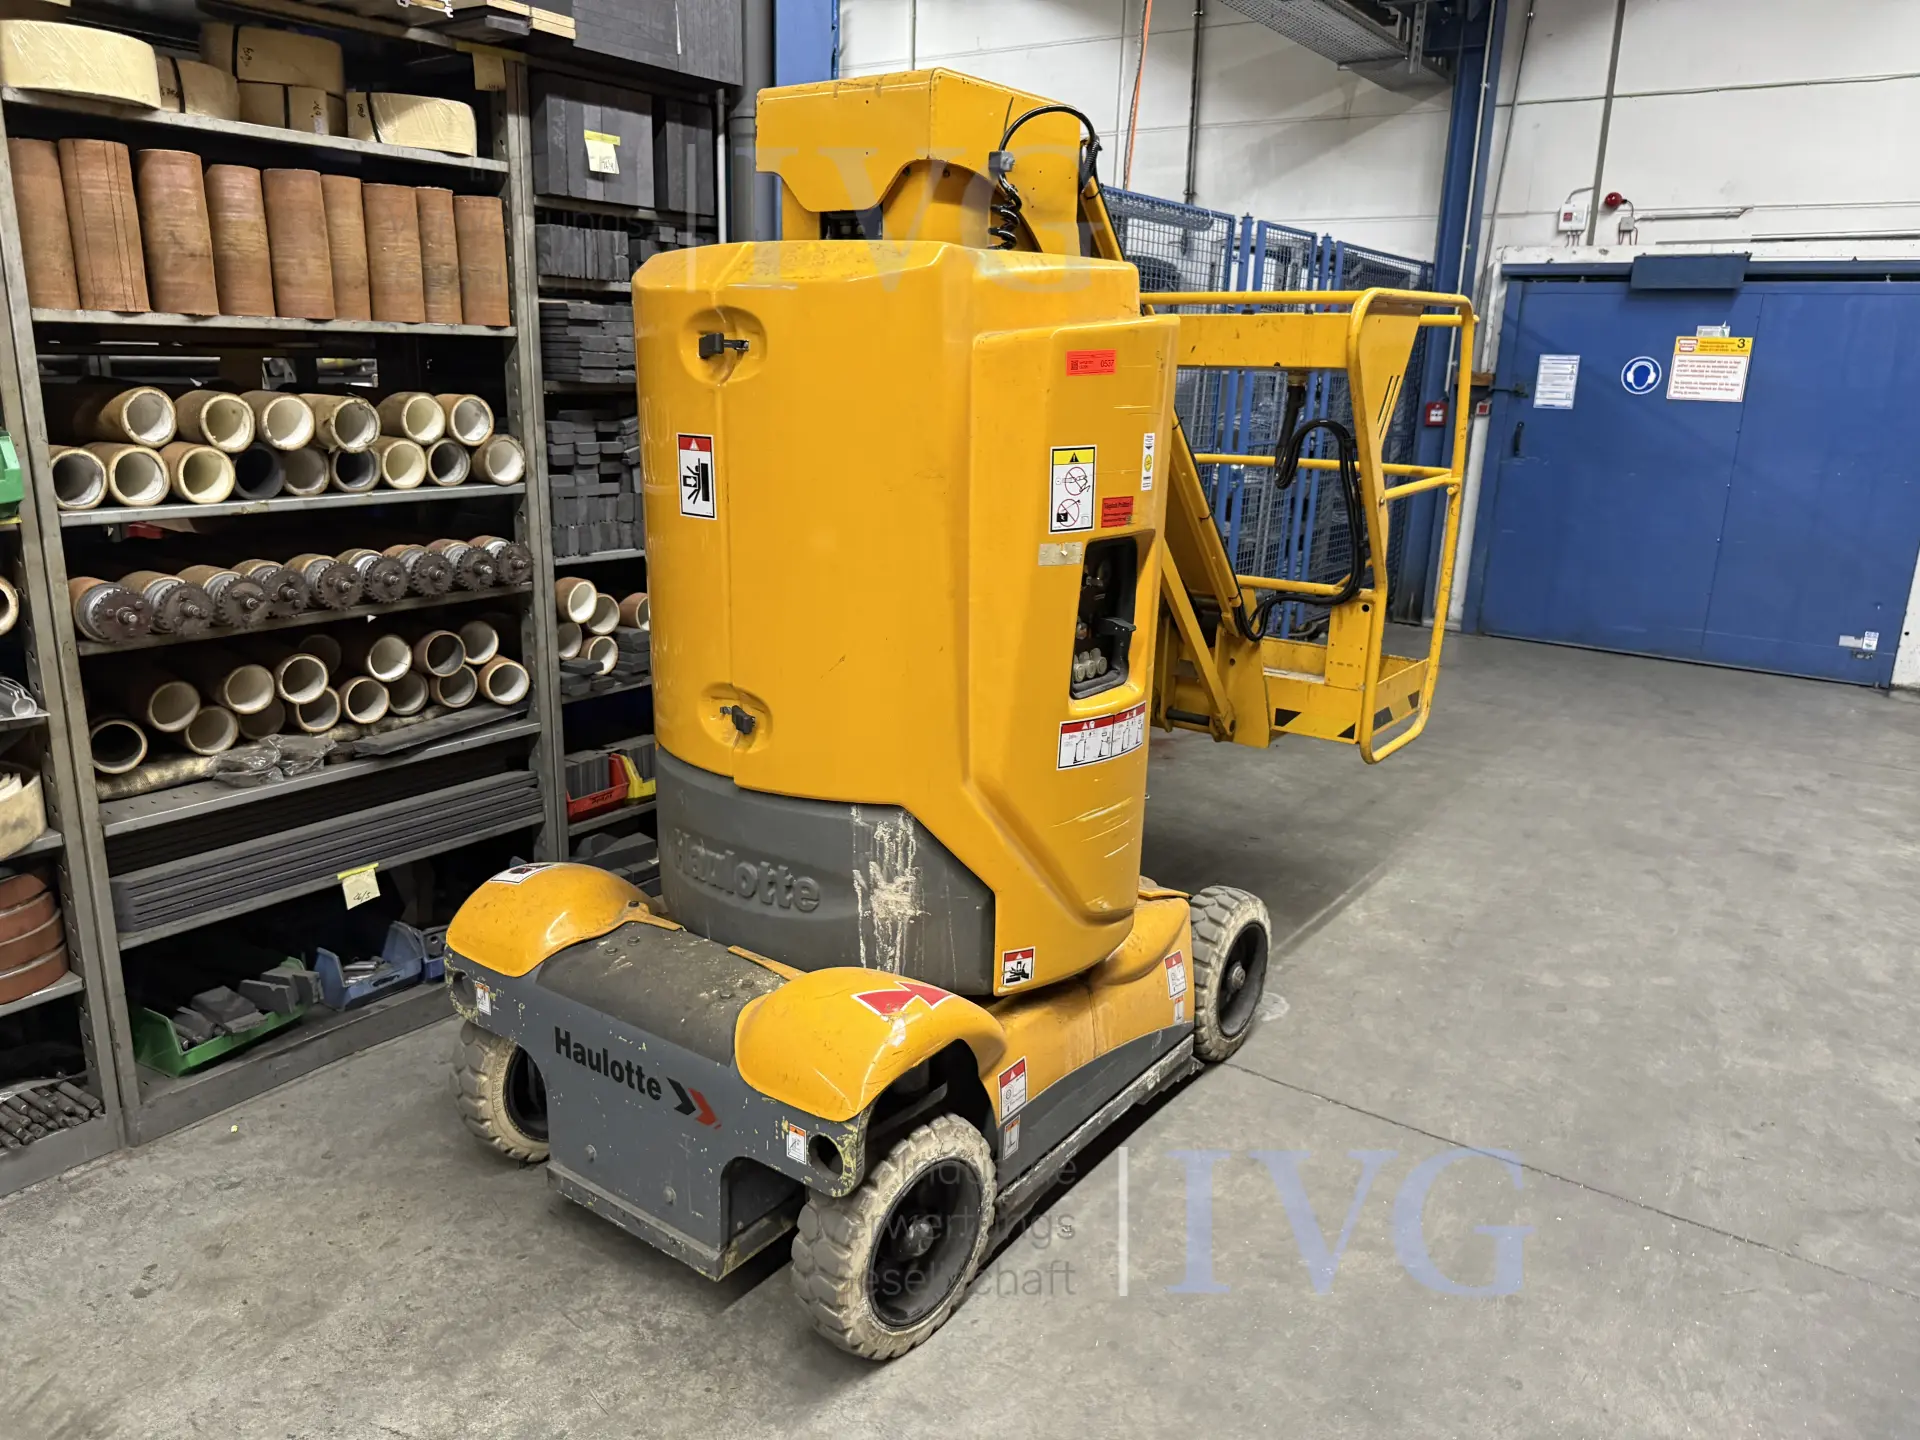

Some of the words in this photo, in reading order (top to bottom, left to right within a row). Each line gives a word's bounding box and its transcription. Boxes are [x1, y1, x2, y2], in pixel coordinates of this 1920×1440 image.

[1737, 338, 1746, 349] 3
[673, 828, 820, 912] Haulotte
[554, 1025, 662, 1101] Haulotte
